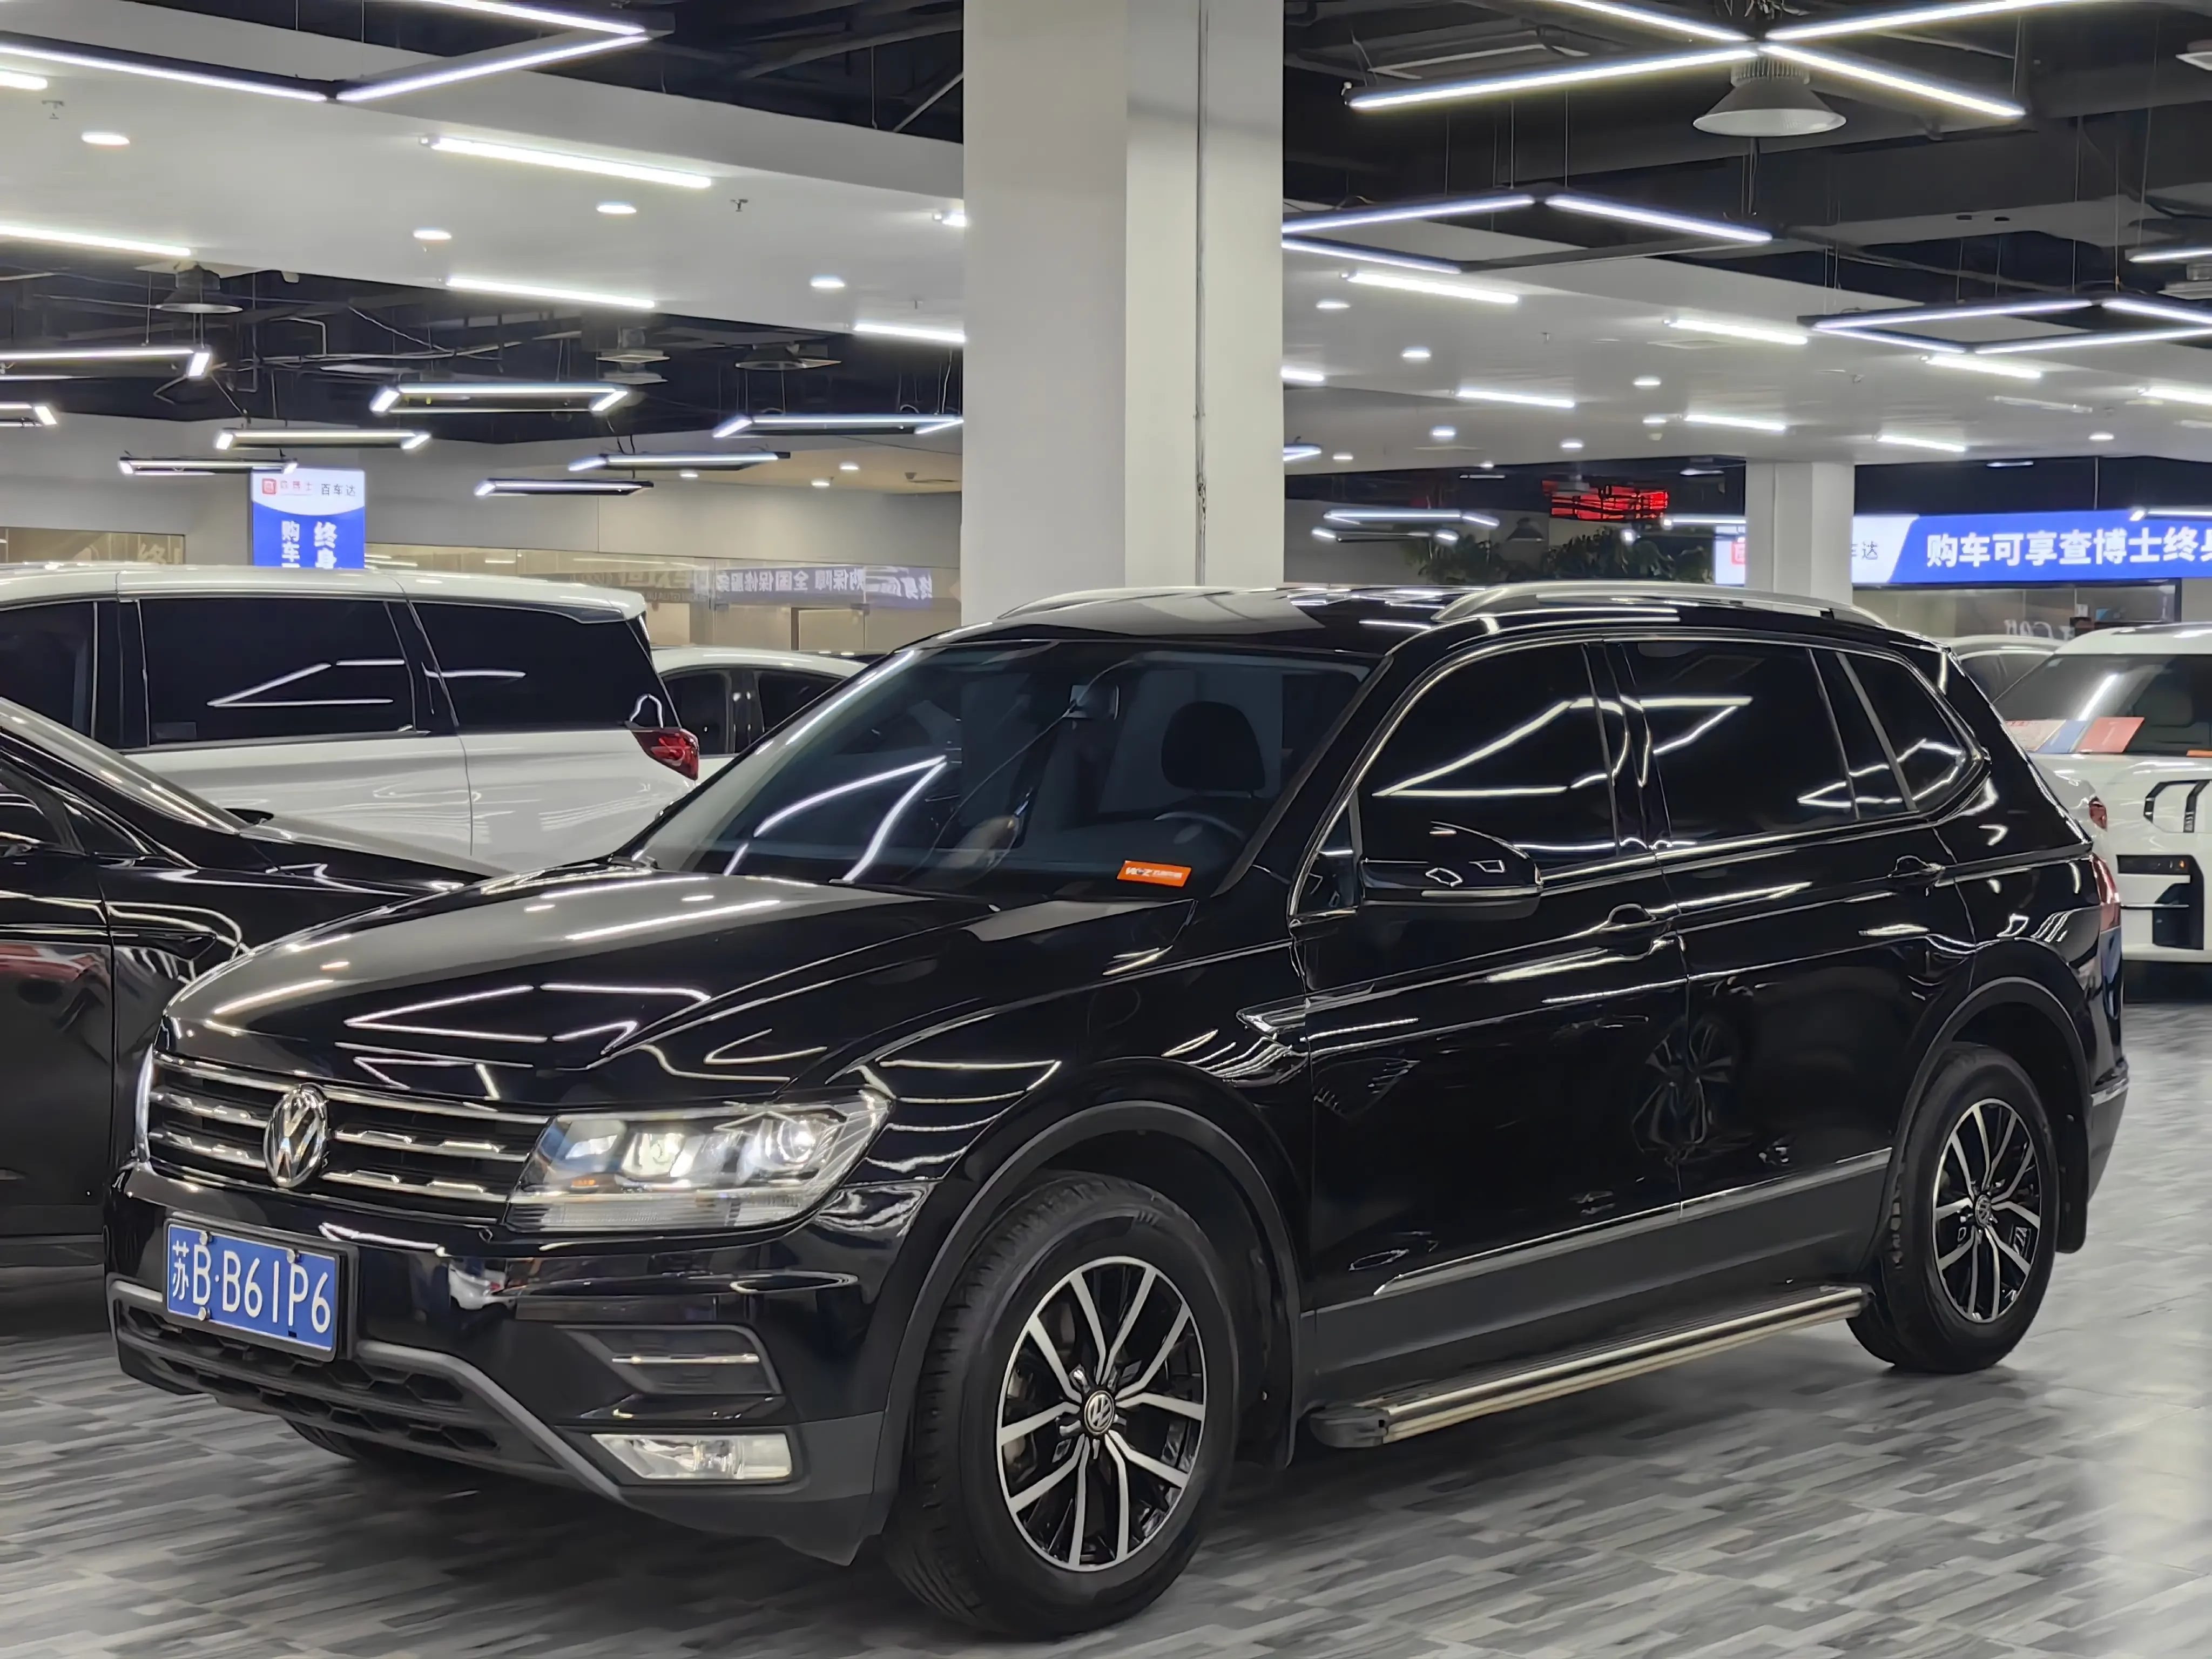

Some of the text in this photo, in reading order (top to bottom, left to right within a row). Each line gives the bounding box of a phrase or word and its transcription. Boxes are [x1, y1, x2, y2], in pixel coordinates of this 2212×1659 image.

[321, 483, 356, 496] 百车达
[281, 520, 300, 568] 购车
